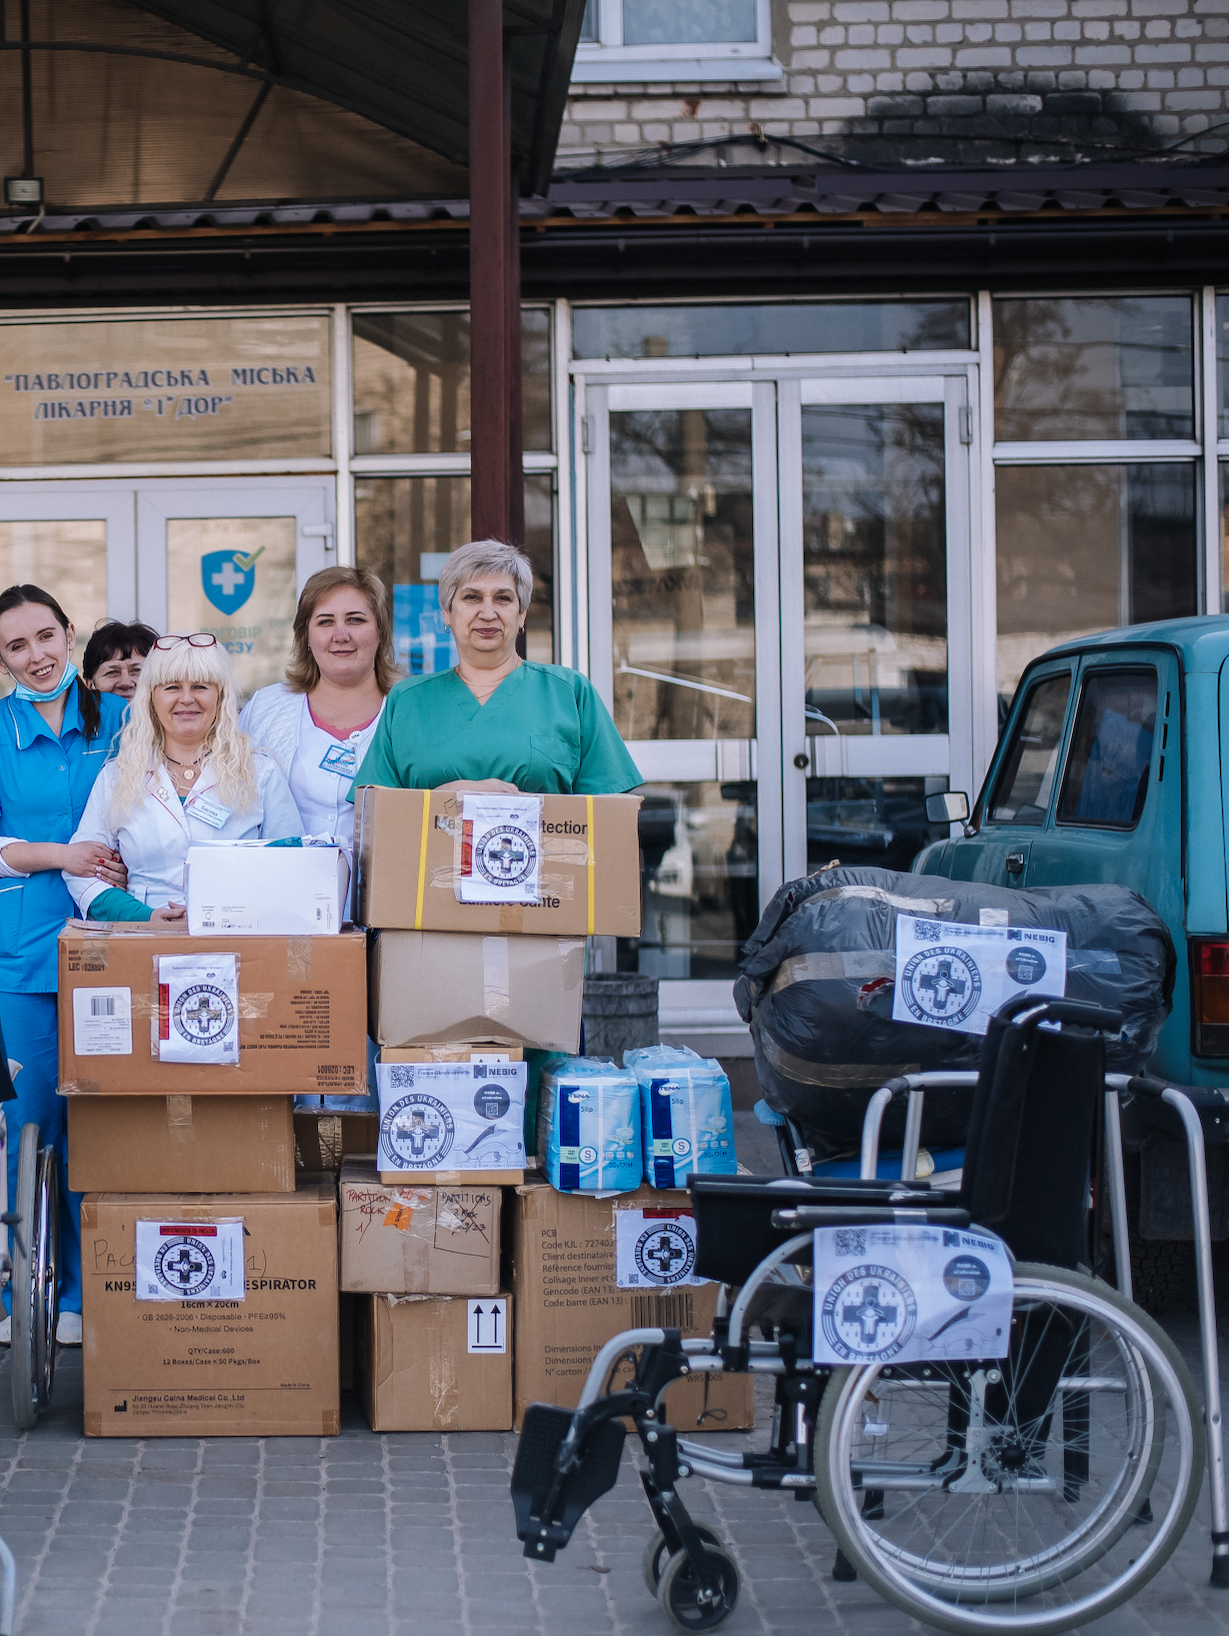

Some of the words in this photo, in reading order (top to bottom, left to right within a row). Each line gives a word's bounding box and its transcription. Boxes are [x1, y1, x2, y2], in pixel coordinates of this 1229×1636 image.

[230, 365, 316, 386] МІСЬКА
[33, 398, 133, 419] ЛІКАРНЯ
[222, 641, 254, 654] СЗУ
[476, 834, 491, 854] UNION
[491, 827, 504, 835] DES
[1024, 933, 1055, 943] NEBIG
[904, 954, 923, 976] UNION
[924, 948, 941, 957] DES
[944, 947, 980, 987] UKRAINIENS
[488, 1068, 518, 1076] NEBIG
[382, 1106, 399, 1130] UNION
[399, 1095, 415, 1107] DES
[417, 1095, 453, 1129] UKRAINIENS
[580, 1105, 593, 1113] Slip
[678, 1141, 685, 1150] S
[584, 1150, 591, 1159] S
[391, 1154, 401, 1166] EN
[541, 1229, 557, 1237] PCB
[666, 1224, 686, 1238] UNION
[685, 1238, 694, 1249] DES
[542, 1241, 562, 1249] Code
[962, 1237, 994, 1250] NEBIG
[542, 1253, 565, 1261] Client
[567, 1251, 614, 1260] destinataire
[542, 1263, 582, 1272] Référence
[245, 1279, 317, 1291] ESPIRATOR
[542, 1276, 576, 1285] Colisage
[578, 1275, 599, 1283] Inner
[543, 1287, 579, 1296] Gencode
[581, 1286, 601, 1294] (EAN
[825, 1279, 846, 1311] UNION
[847, 1268, 866, 1281] DES
[870, 1266, 916, 1311] UKRAINIENS
[544, 1299, 564, 1307] Code
[566, 1298, 587, 1306] barre
[589, 1298, 609, 1306] (EAN
[200, 1313, 242, 1321] Disposable
[173, 1325, 221, 1333] Non-Medical
[223, 1325, 254, 1333] Devices
[544, 1345, 592, 1353] Dimensions
[545, 1356, 592, 1365] Dimensions
[556, 1367, 582, 1376] carton
[132, 1395, 162, 1403] Jiangsu
